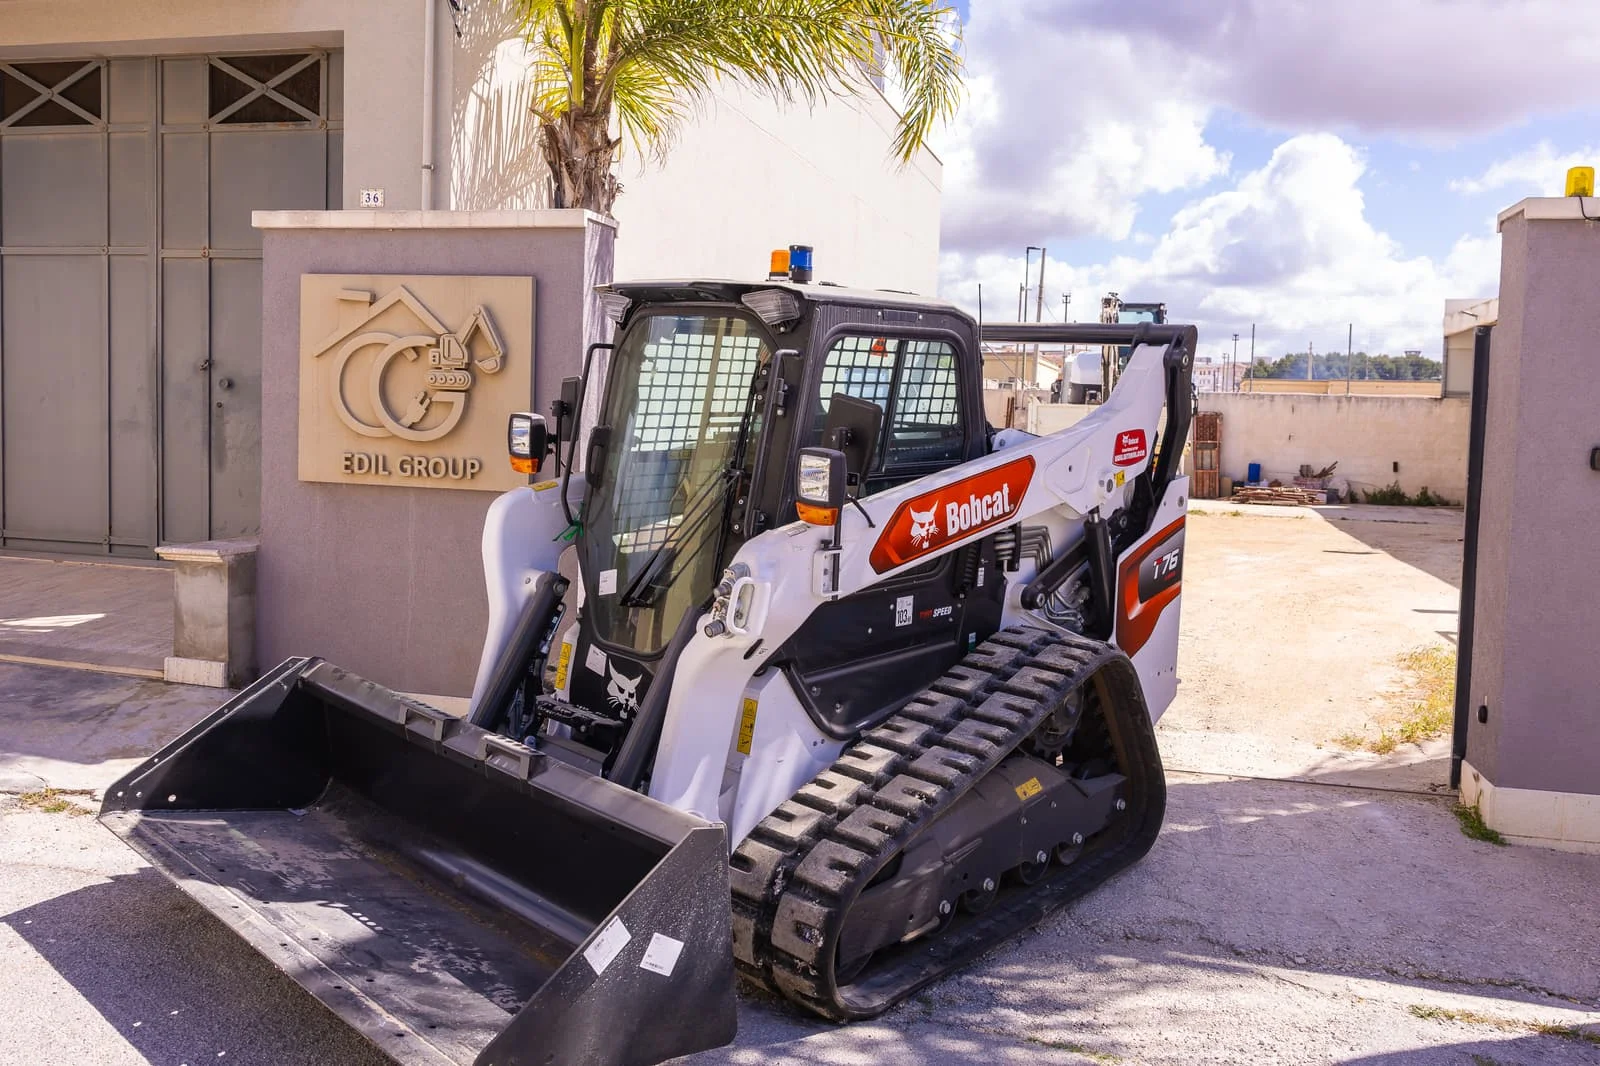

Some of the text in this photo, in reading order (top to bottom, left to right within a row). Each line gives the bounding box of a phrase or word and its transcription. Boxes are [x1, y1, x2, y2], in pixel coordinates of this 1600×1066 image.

[365, 192, 379, 203] 36
[342, 451, 483, 481] EDIL GROUP
[946, 482, 1010, 537] Bobcat
[1154, 548, 1179, 580] T76
[897, 608, 908, 626] 103
[933, 605, 952, 617] SPEED
